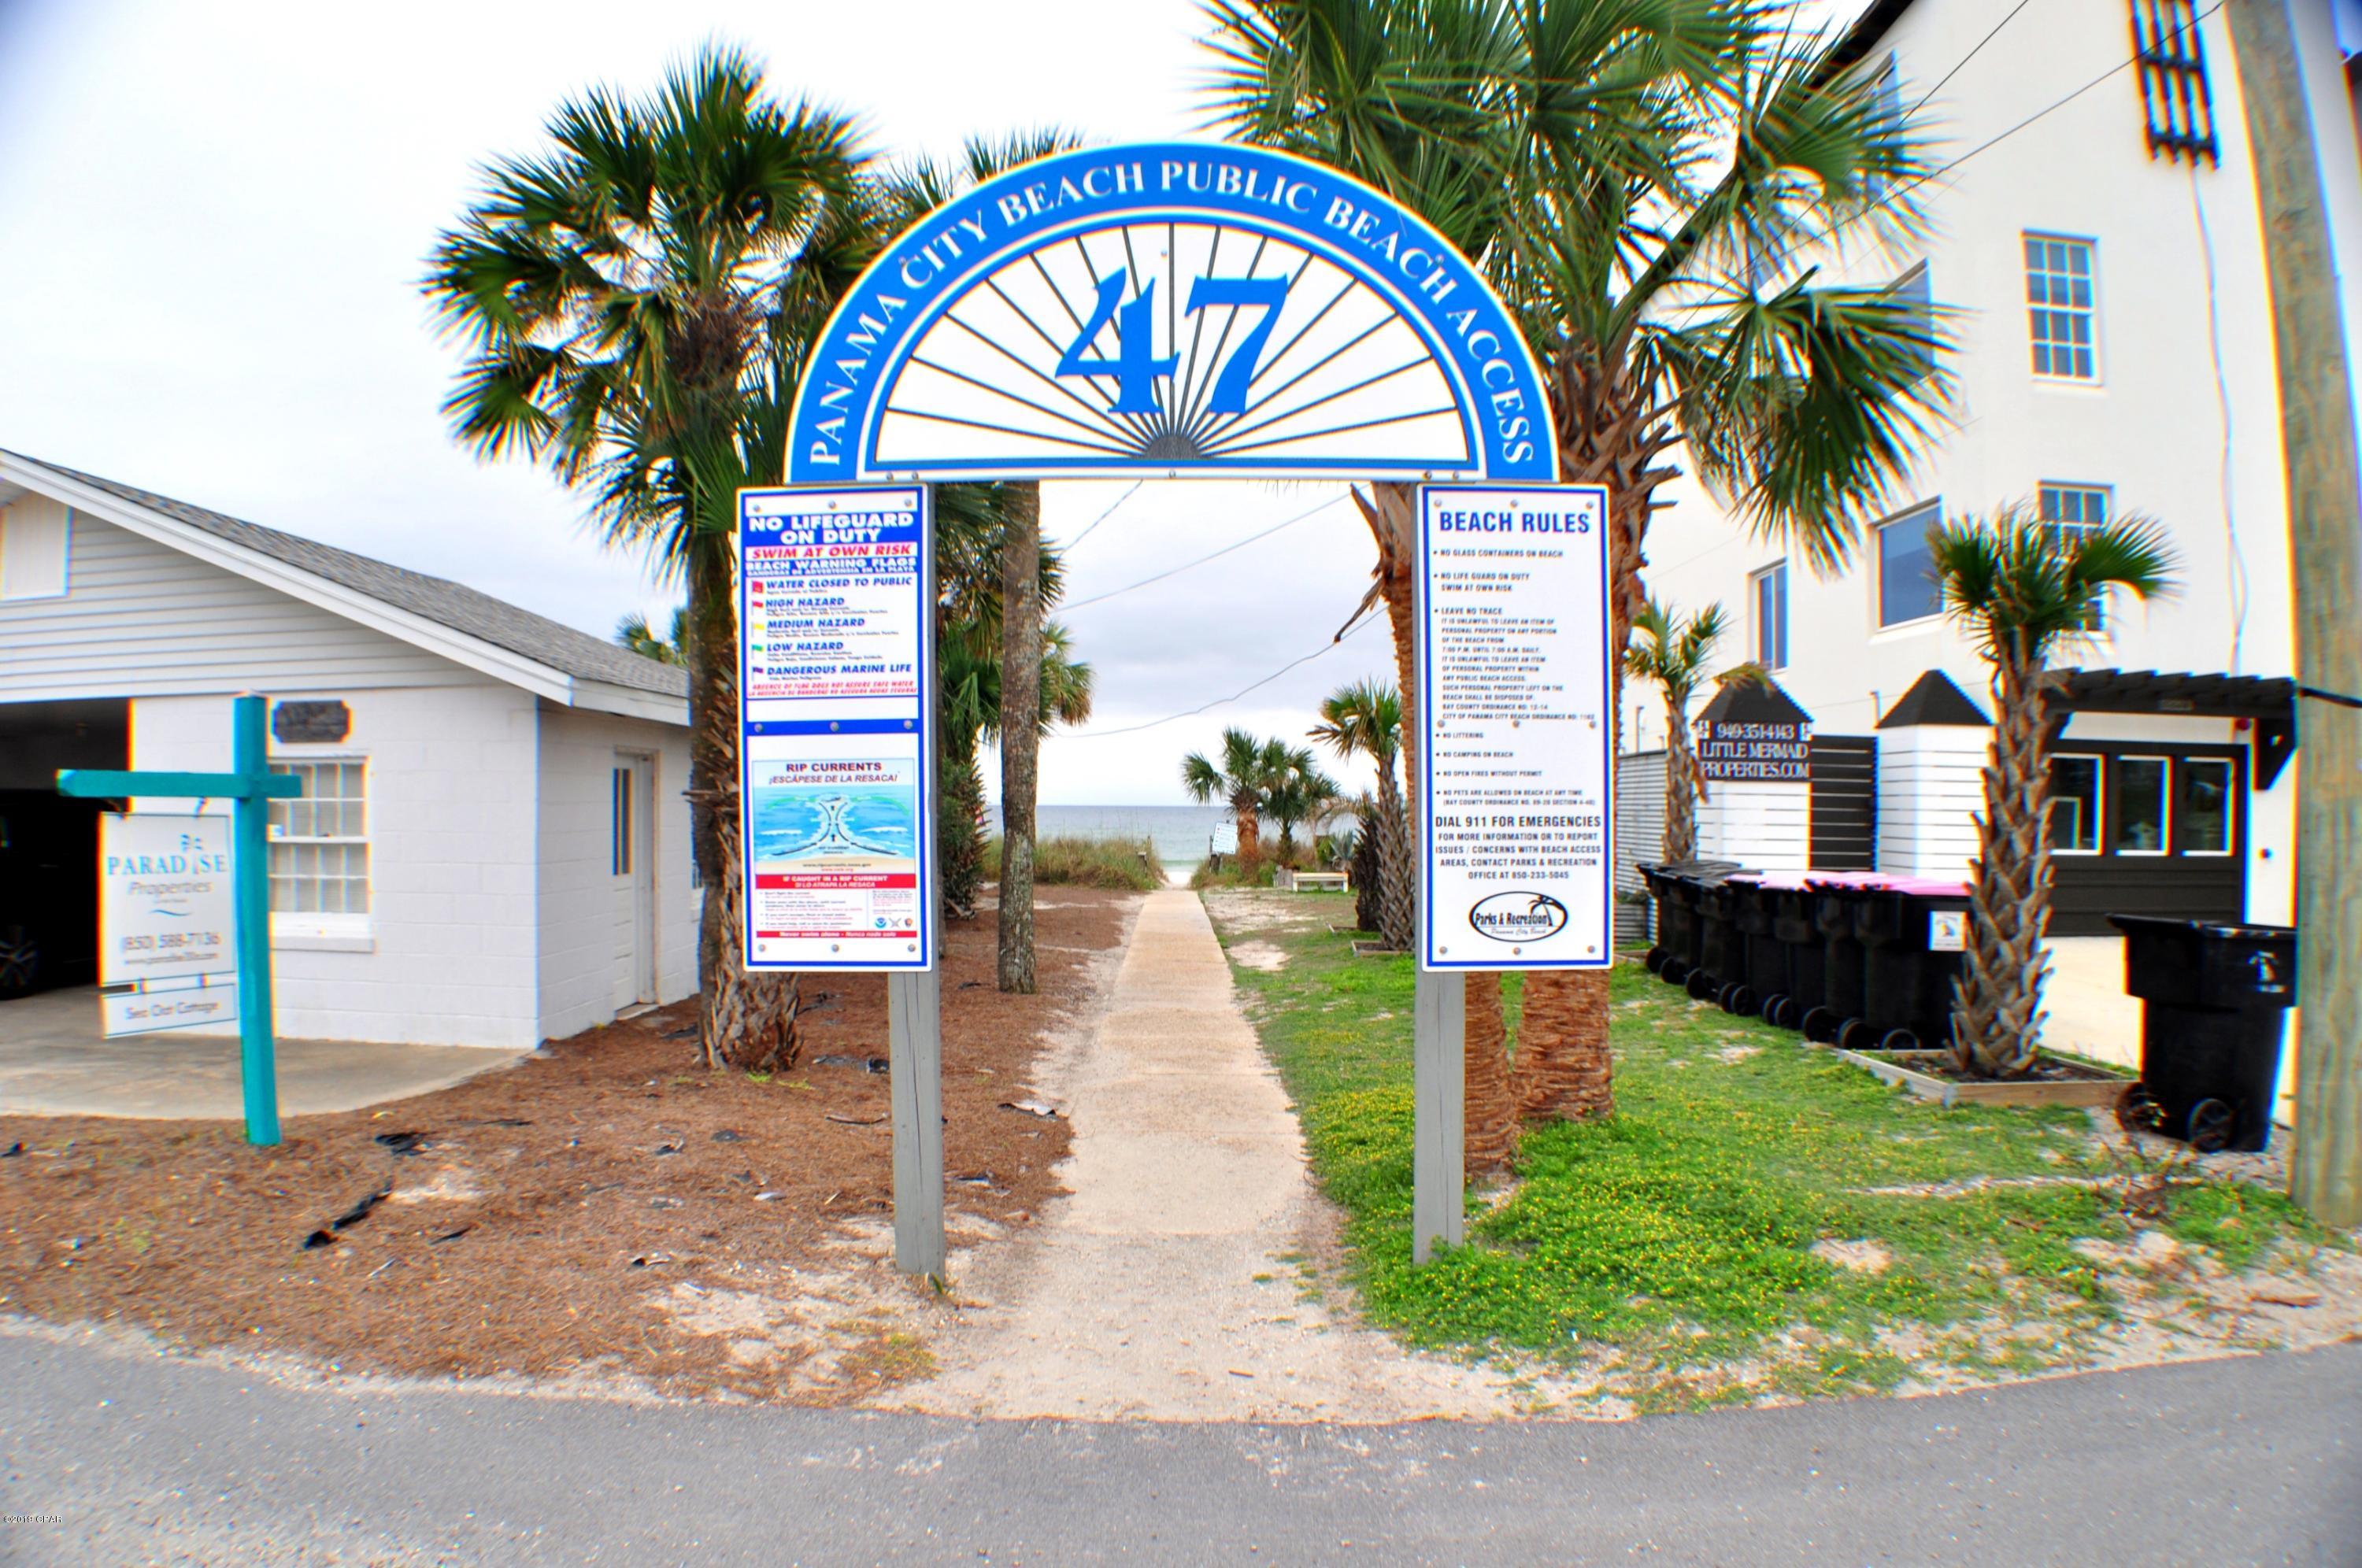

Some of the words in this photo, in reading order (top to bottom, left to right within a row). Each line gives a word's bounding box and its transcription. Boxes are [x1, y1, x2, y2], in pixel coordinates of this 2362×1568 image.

[809, 294, 906, 465] PANAMA
[901, 209, 987, 290] CITY
[997, 162, 1144, 227] BEACH
[1161, 161, 1318, 213] PUBLIC
[1324, 195, 1457, 305] BEACH
[1446, 308, 1534, 464] ACCESS
[1054, 265, 1288, 414] 47
[750, 516, 783, 531] NO
[791, 512, 914, 530] LIFEGUARD
[1439, 512, 1512, 533] BEACH
[1522, 512, 1590, 534] RULES
[780, 530, 815, 545] ON
[824, 528, 881, 544] DUTY
[752, 548, 797, 559] SWIM
[805, 547, 824, 557] AT
[828, 545, 870, 557] OWN
[875, 545, 911, 556] RISK
[746, 560, 790, 571] BEACH
[795, 558, 867, 570] WARNING
[872, 557, 916, 568] FLAGS
[766, 579, 804, 589] WATER
[809, 579, 850, 588] CLOSED
[855, 578, 868, 586] TO
[873, 577, 912, 586] PUBLIC
[765, 598, 794, 607] HIGH
[798, 597, 845, 607] HAZARD
[767, 619, 813, 628] MEDIUM
[818, 618, 865, 627] HAZARD
[767, 642, 793, 652] LOW
[797, 642, 843, 651] HAZARD
[767, 665, 836, 675] DANGEROUS
[841, 664, 886, 674] MARINE
[890, 664, 912, 672] LIFE
[1703, 741, 1747, 757] LITTLE
[1748, 742, 1809, 759] MERMAID
[786, 764, 807, 772] RIP
[812, 762, 882, 772] CURRENTS
[1701, 761, 1810, 778] PROPERTIES.COM
[825, 775, 838, 783] DE
[1435, 816, 1461, 827] DIAL
[1465, 816, 1486, 827] 911
[1492, 816, 1515, 827] FOR
[1519, 816, 1601, 827] EMERGENCIES
[107, 855, 228, 875] PARADISE
[128, 881, 214, 897] Properties
[1475, 913, 1497, 926] Parks
[1498, 913, 1504, 926] &
[1507, 913, 1548, 926] Recreation
